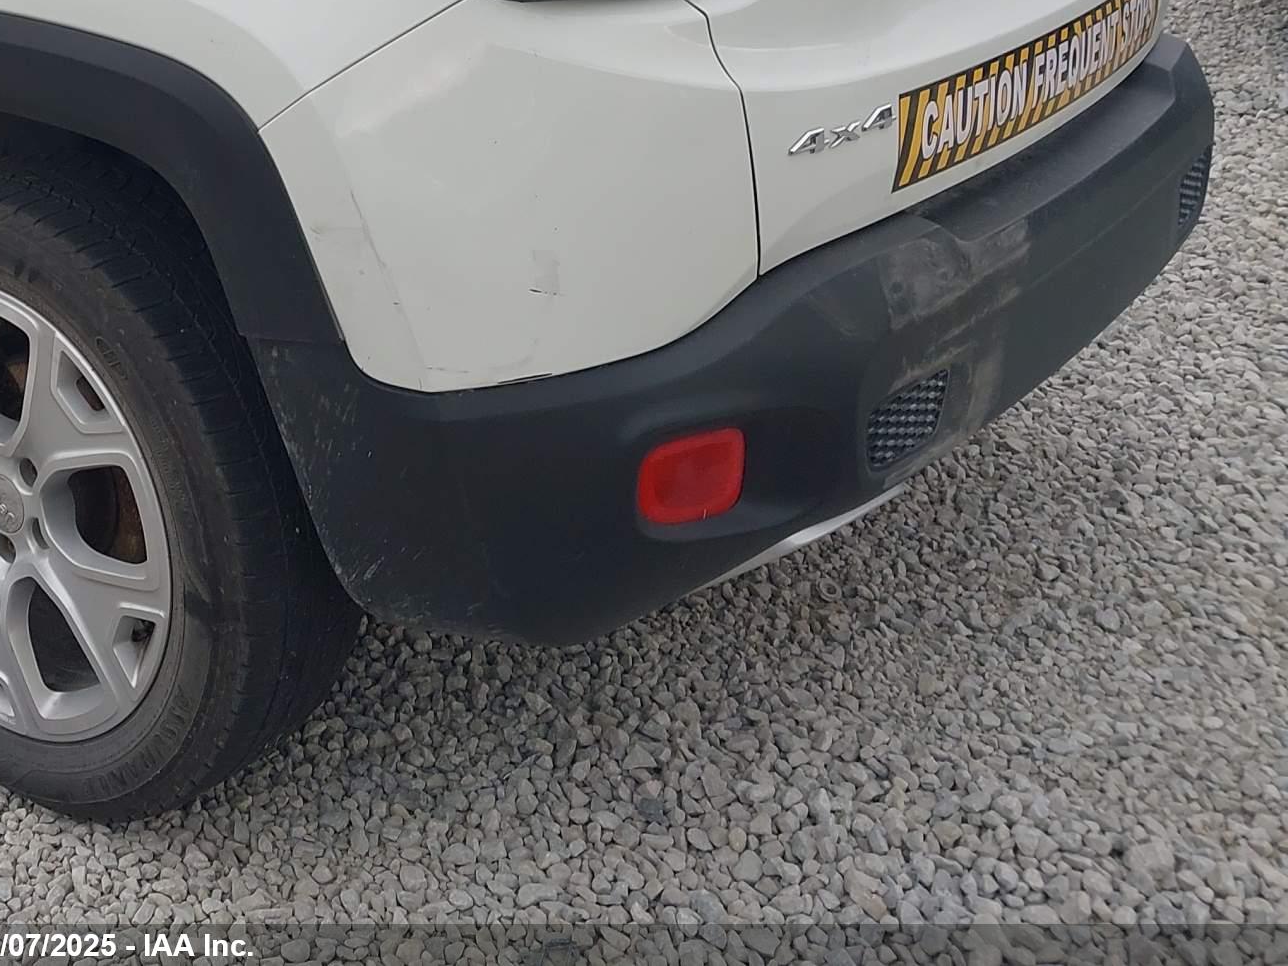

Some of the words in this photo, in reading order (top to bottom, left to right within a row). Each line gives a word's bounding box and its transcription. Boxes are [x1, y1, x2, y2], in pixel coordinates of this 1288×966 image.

[788, 103, 897, 155] 4x4
[921, 61, 1028, 160] CAUTION
[1031, 8, 1122, 109] FREQUENT
